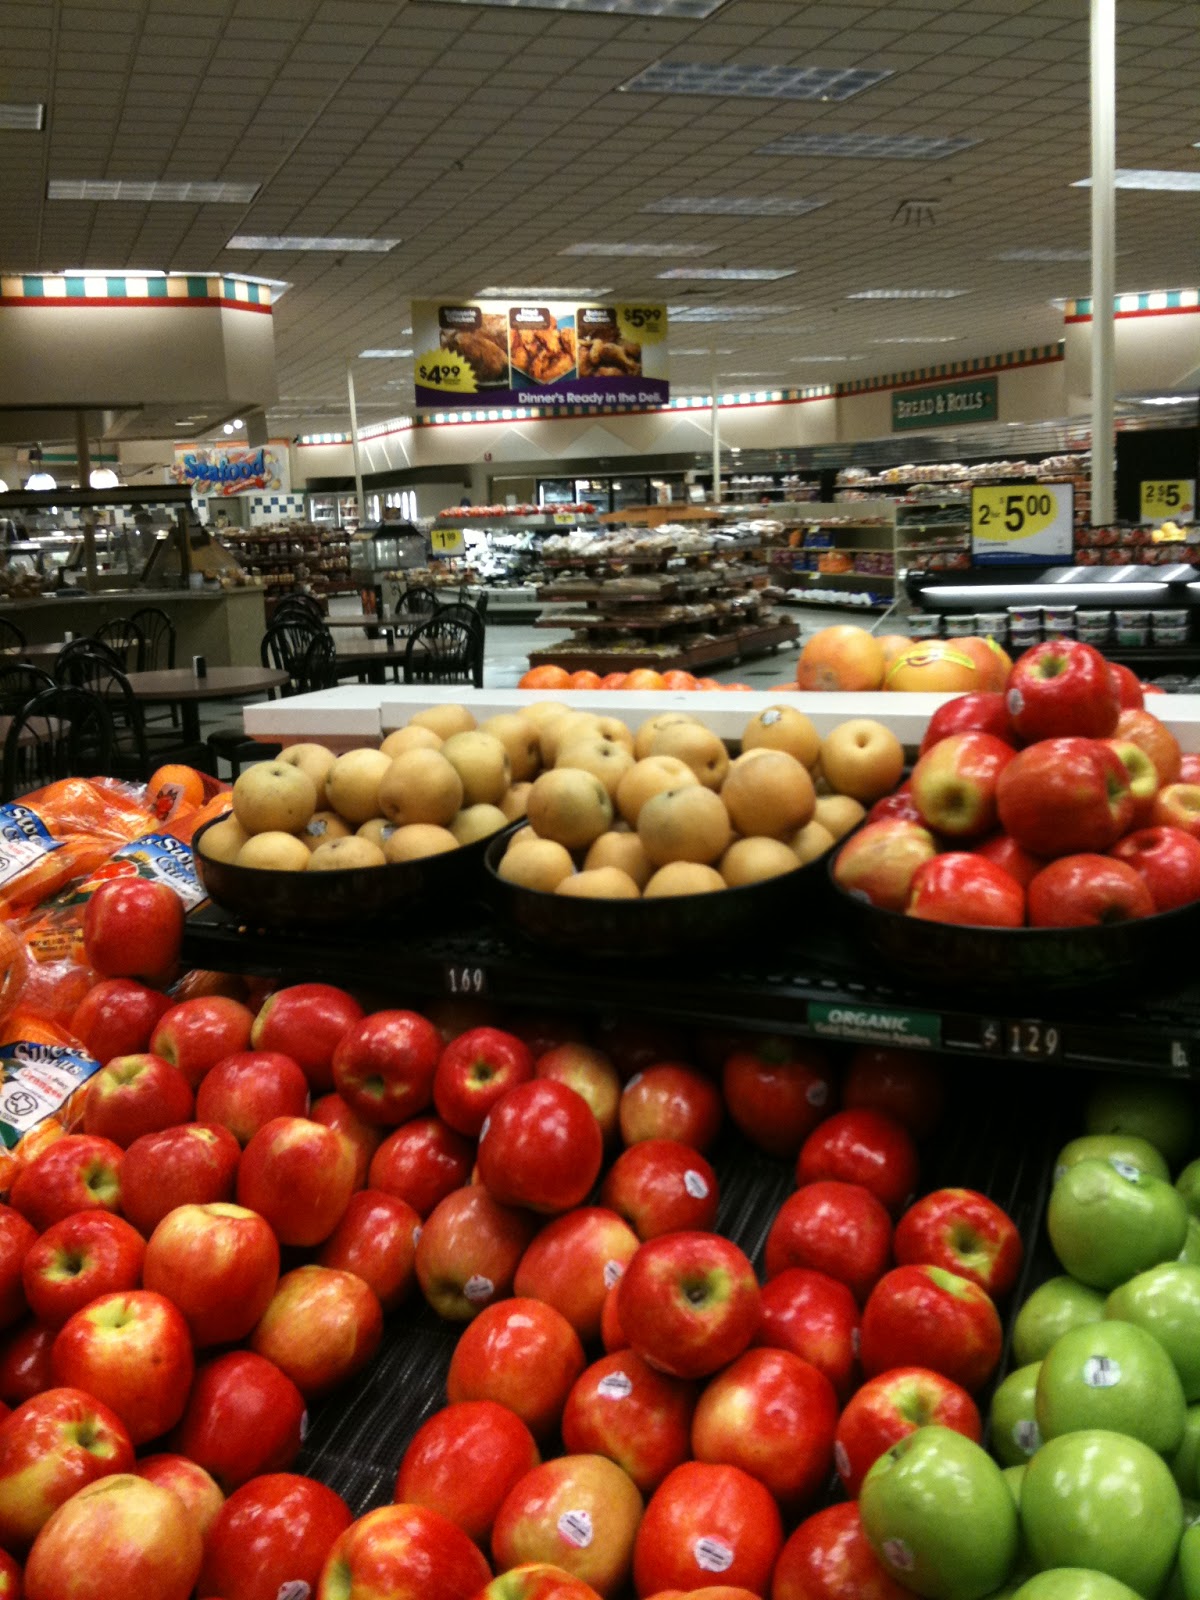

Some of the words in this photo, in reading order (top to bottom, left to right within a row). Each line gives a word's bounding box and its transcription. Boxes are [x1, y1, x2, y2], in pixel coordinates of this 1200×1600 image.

[518, 392, 565, 404] Dinner's
[566, 392, 604, 405] Ready
[605, 392, 616, 403] in
[618, 392, 637, 403] the
[897, 398, 935, 419] BREAD
[946, 391, 983, 412] ROLLS
[183, 449, 265, 484] Seafood
[978, 504, 991, 525] 2
[828, 1009, 911, 1032] ORGANIC
